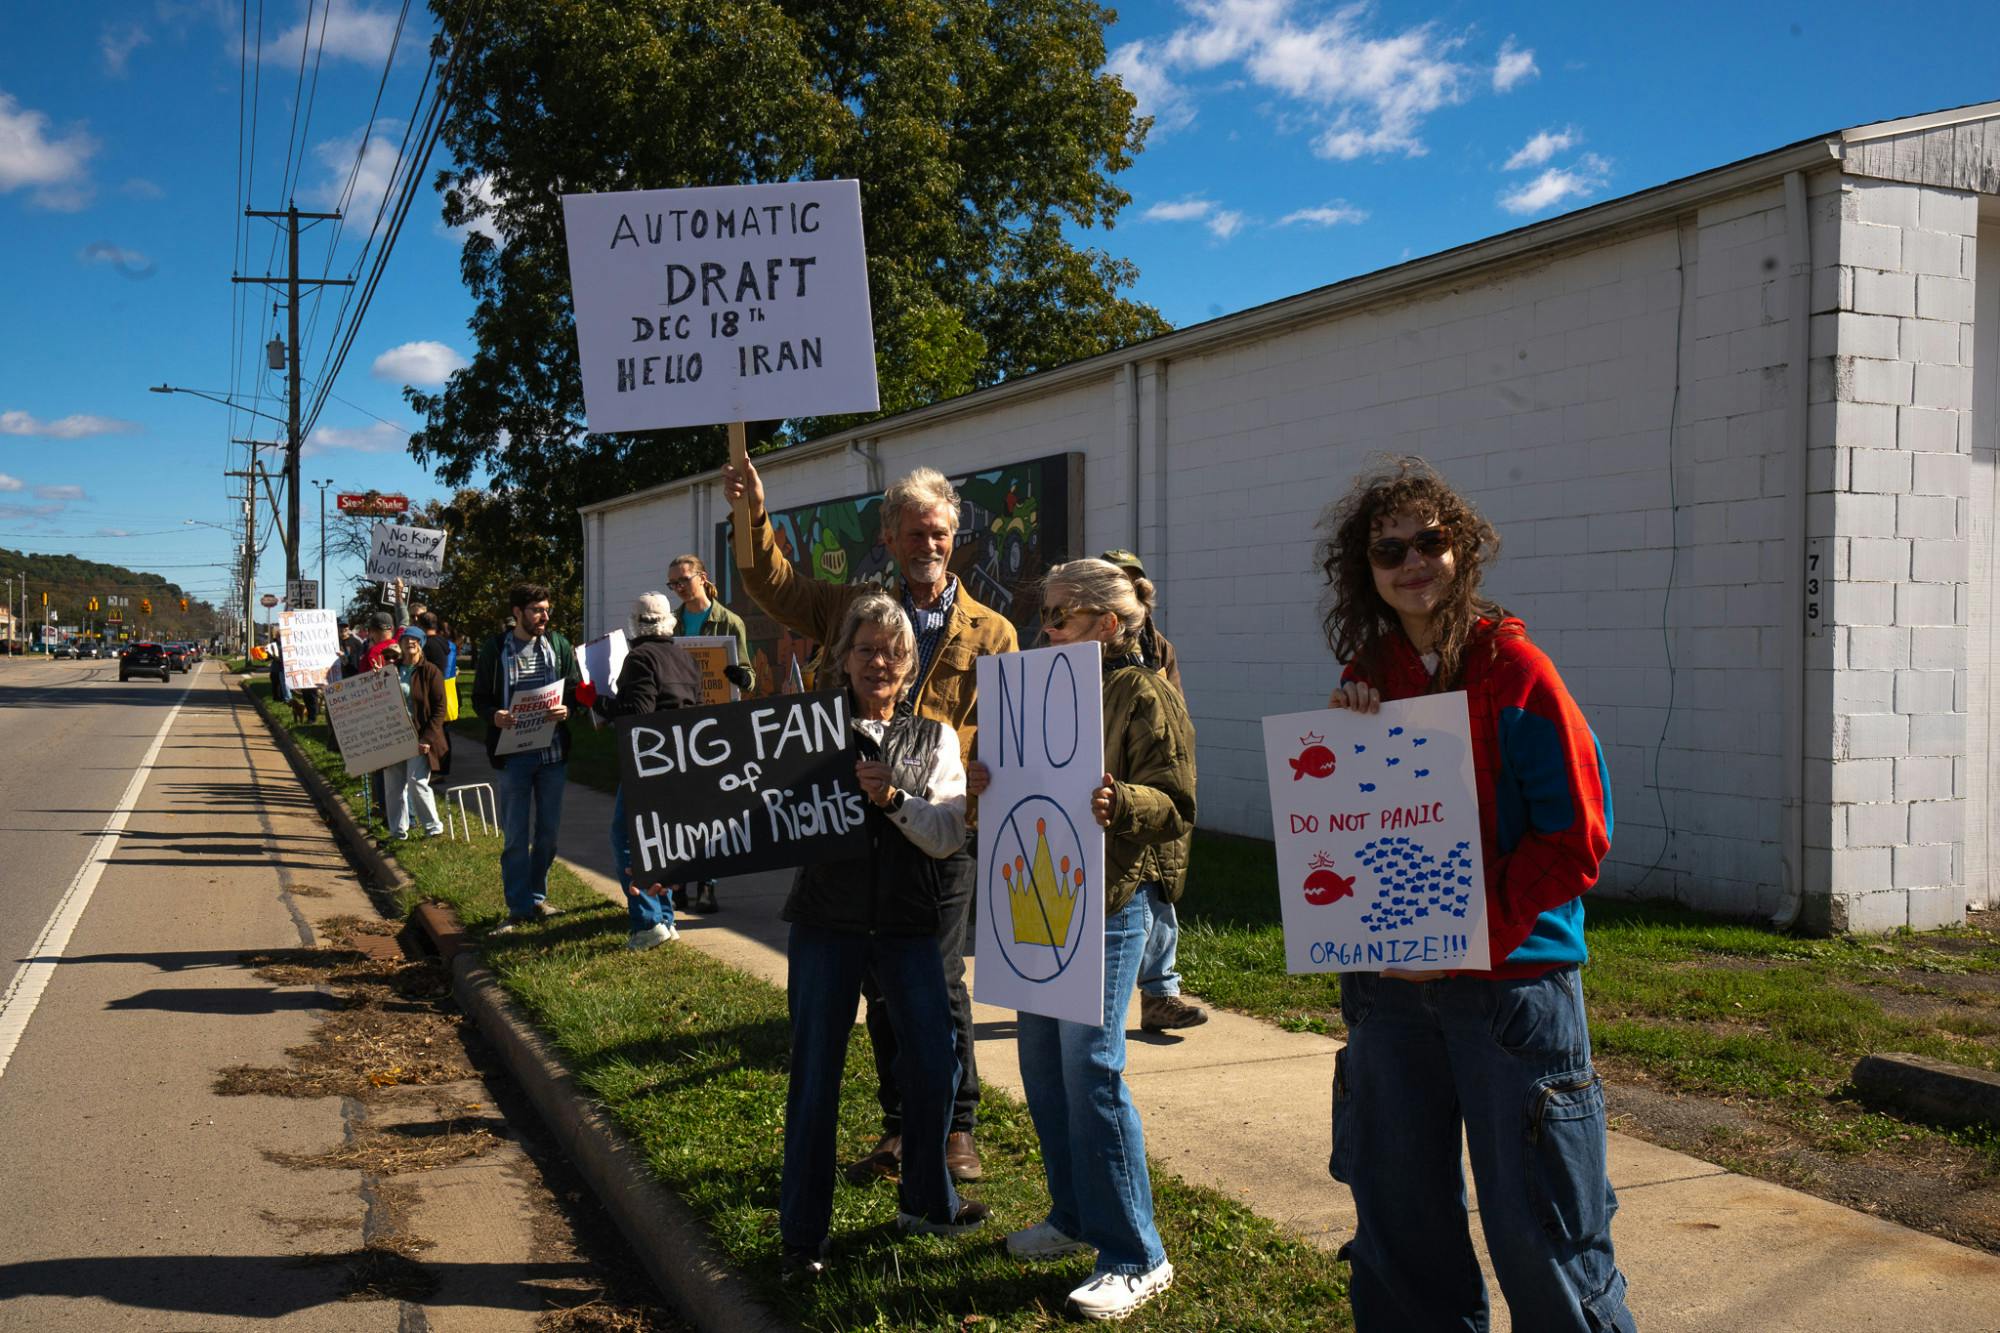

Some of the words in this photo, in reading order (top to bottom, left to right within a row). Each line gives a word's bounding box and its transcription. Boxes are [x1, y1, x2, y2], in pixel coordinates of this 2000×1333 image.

[609, 202, 820, 249] AUTOMATIC
[663, 256, 816, 306] DRAFT
[631, 314, 690, 342] DEC
[616, 352, 703, 392] HELLO
[738, 337, 823, 377] IRAN
[378, 541, 396, 557] No
[389, 528, 408, 542] No
[368, 559, 385, 574] No
[1808, 554, 1819, 619] 735
[511, 695, 560, 713] FREEDOM
[998, 652, 1078, 768] NO
[631, 718, 731, 778] BIG
[751, 695, 846, 760] FAN
[719, 761, 762, 792] of
[761, 779, 865, 843] Rights
[1290, 813, 1318, 833] DO
[1330, 812, 1370, 833] NOT
[1380, 801, 1444, 829] PANIC
[1310, 934, 1467, 968] ORGANIZE!!!
